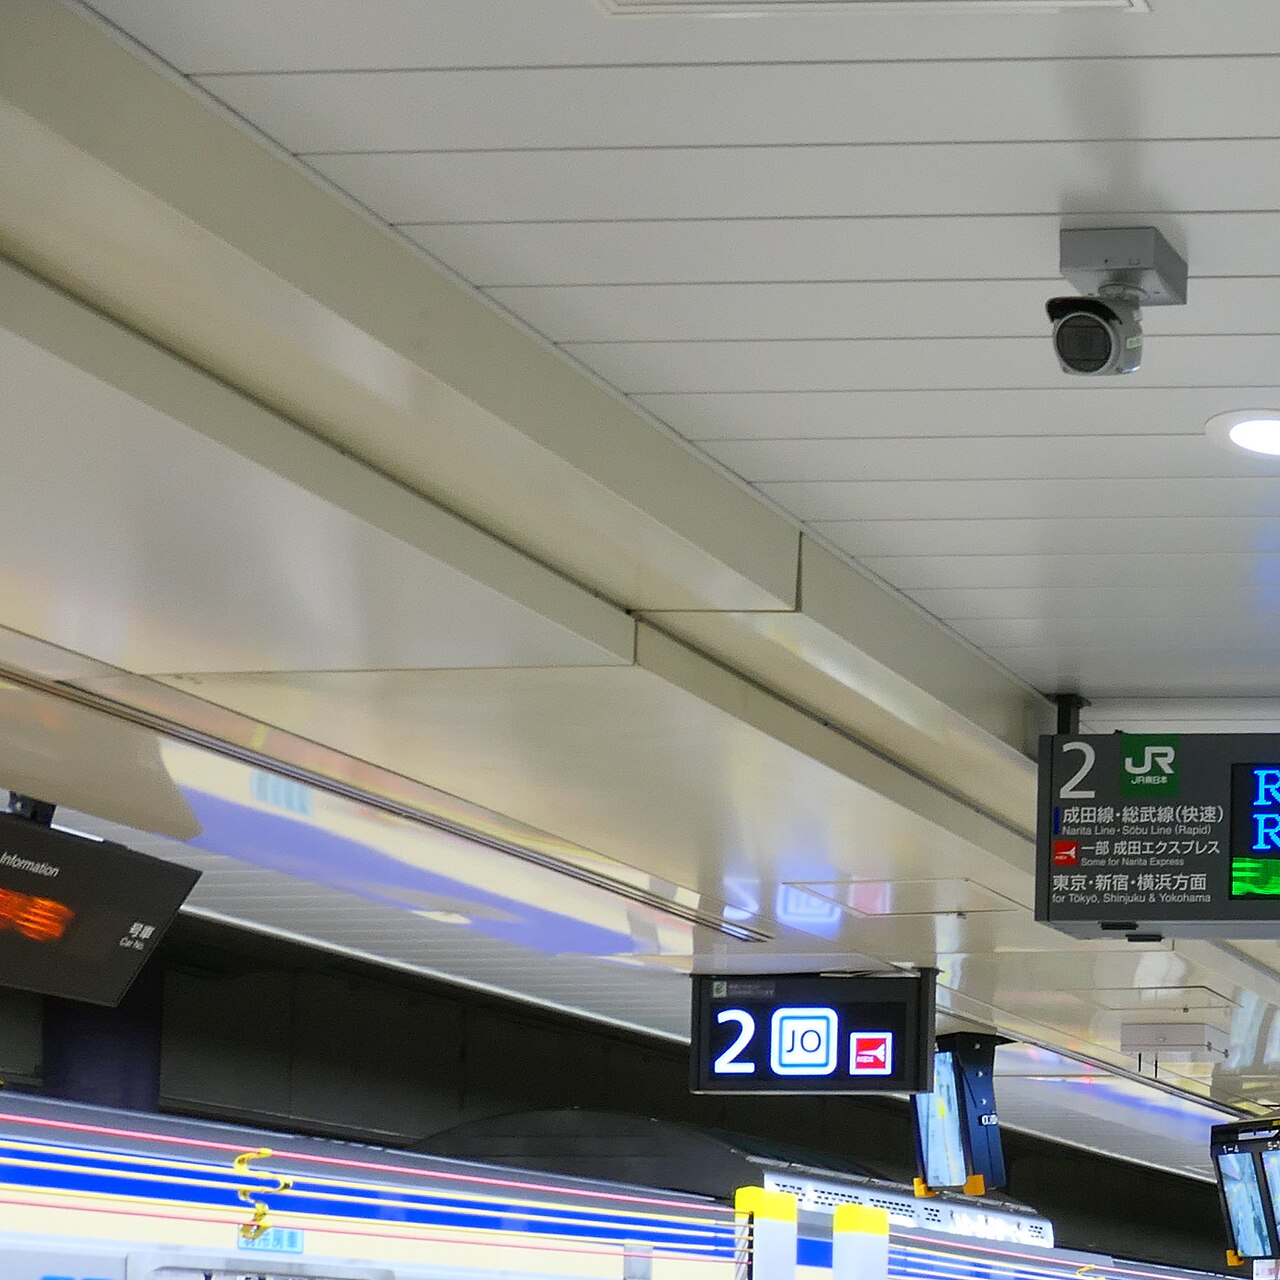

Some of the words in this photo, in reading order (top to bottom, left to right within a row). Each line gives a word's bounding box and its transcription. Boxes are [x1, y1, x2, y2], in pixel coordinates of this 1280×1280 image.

[1124, 745, 1176, 775] JR
[1059, 741, 1096, 799] 2
[1062, 825, 1093, 836] Narita
[1150, 825, 1172, 836] Line
[1174, 825, 1212, 837] (Rapid)
[1081, 841, 1110, 856] 一部
[1113, 840, 1221, 856] 成田エクスプレス
[1081, 857, 1107, 867] Some
[1107, 857, 1120, 867] for
[1121, 857, 1148, 867] Narita
[1149, 857, 1185, 869] Express
[1052, 873, 1208, 892] 東京・新宿・横浜方面
[1052, 892, 1067, 903] for
[1102, 892, 1146, 905] Shinjuku
[1148, 893, 1156, 902] &
[1157, 892, 1211, 903] Yokohama
[713, 1007, 756, 1075] 2
[786, 1029, 822, 1054] JO
